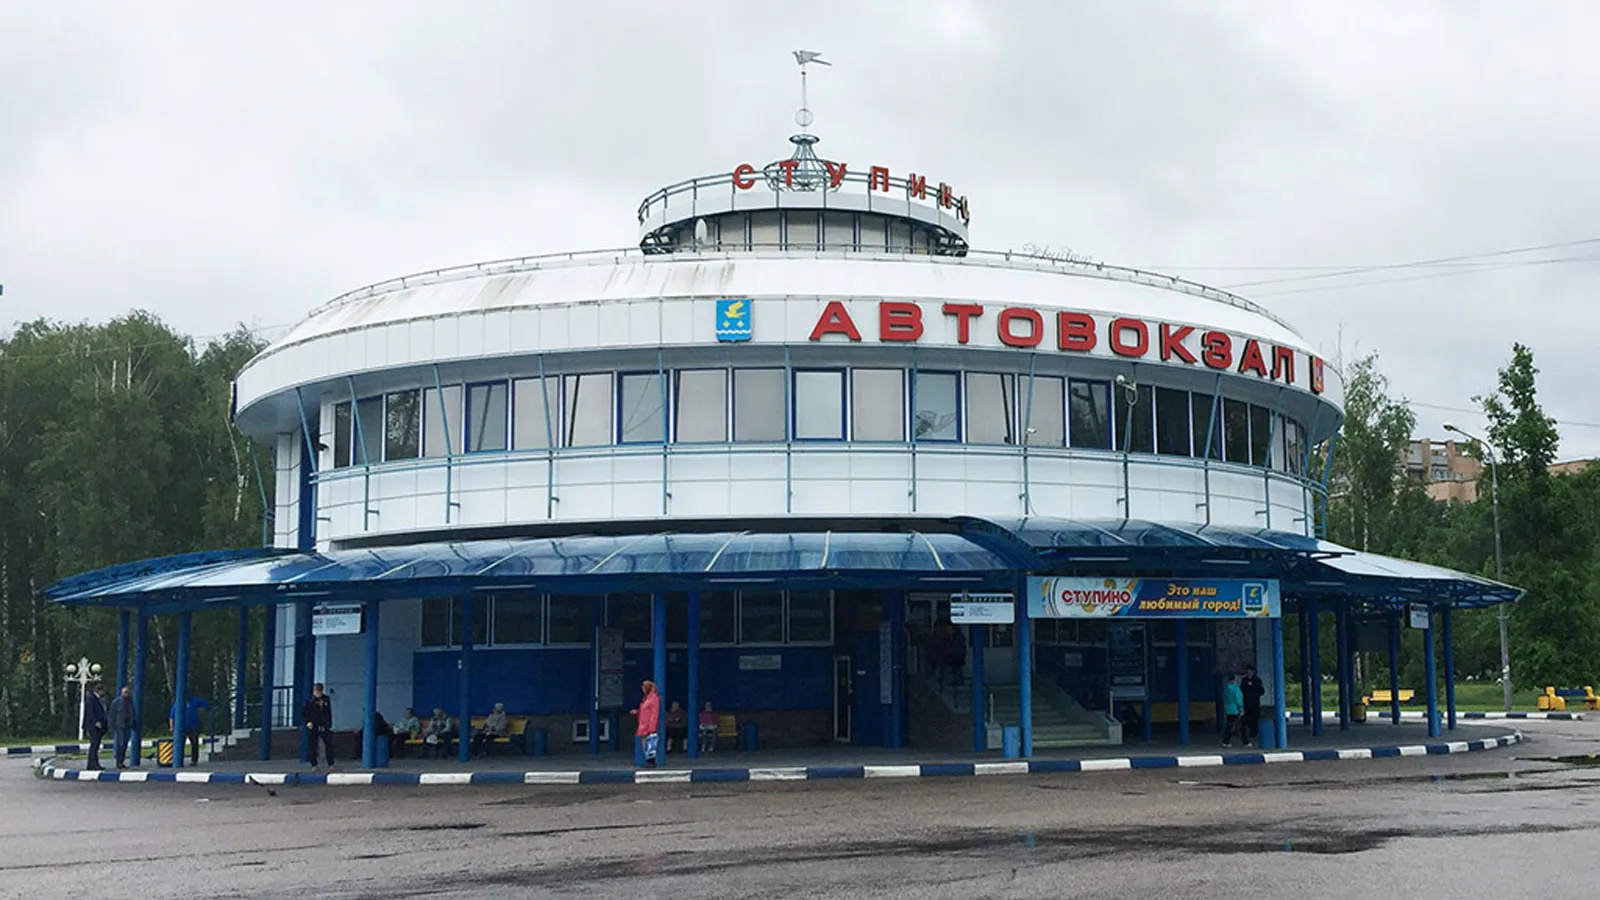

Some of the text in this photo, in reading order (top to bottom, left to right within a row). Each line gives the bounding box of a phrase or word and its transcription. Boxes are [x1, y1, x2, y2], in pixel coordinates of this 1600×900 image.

[733, 160, 970, 219] СТУПИНО
[809, 300, 1295, 384] АВТОВОКЗАЛ
[1061, 589, 1132, 605] СТУПИНО
[1166, 583, 1217, 596] Это наш
[1138, 598, 1241, 613] любимый город!
